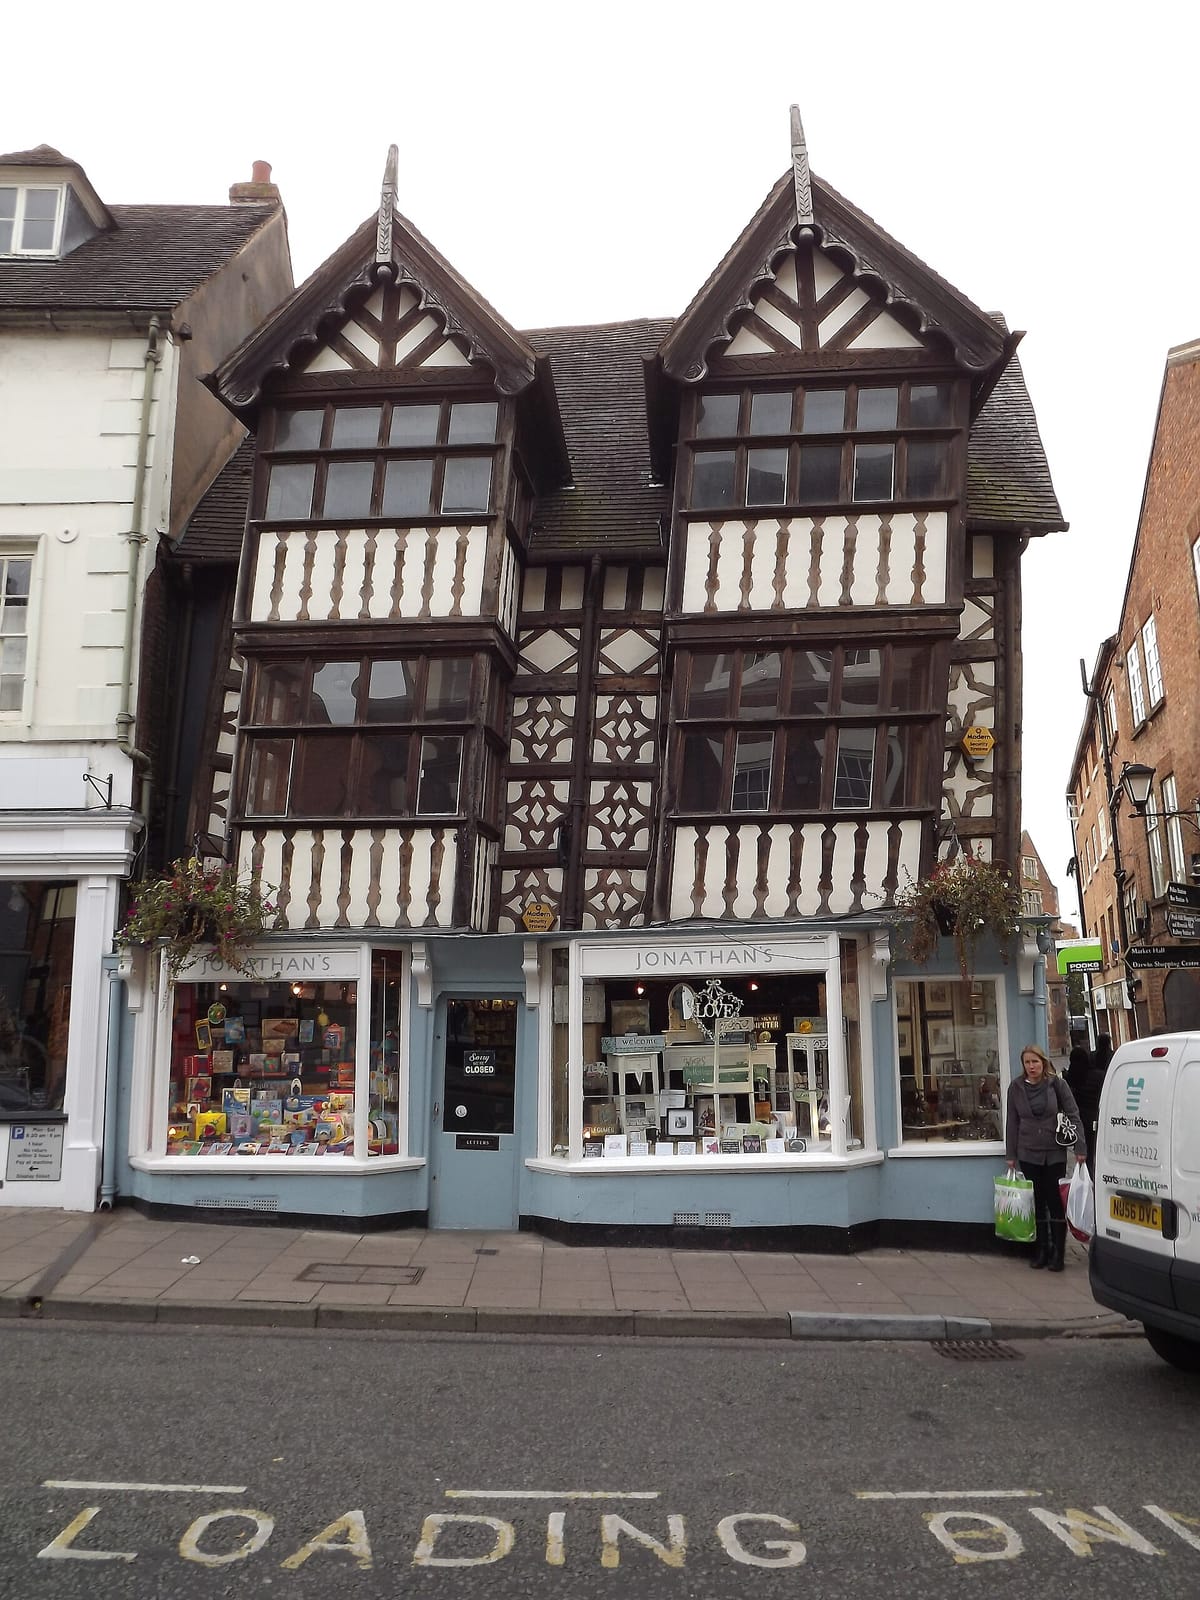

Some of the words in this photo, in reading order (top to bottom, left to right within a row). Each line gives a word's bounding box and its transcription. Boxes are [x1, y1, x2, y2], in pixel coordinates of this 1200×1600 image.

[636, 946, 773, 970] JONATHAN'S
[1154, 961, 1180, 969] Shopping
[695, 1002, 734, 1019] LOVE
[469, 1053, 490, 1064] Sorry
[465, 1065, 494, 1074] CLOSED
[1113, 1199, 1136, 1220] NU56
[36, 1506, 808, 1569] LOADING
